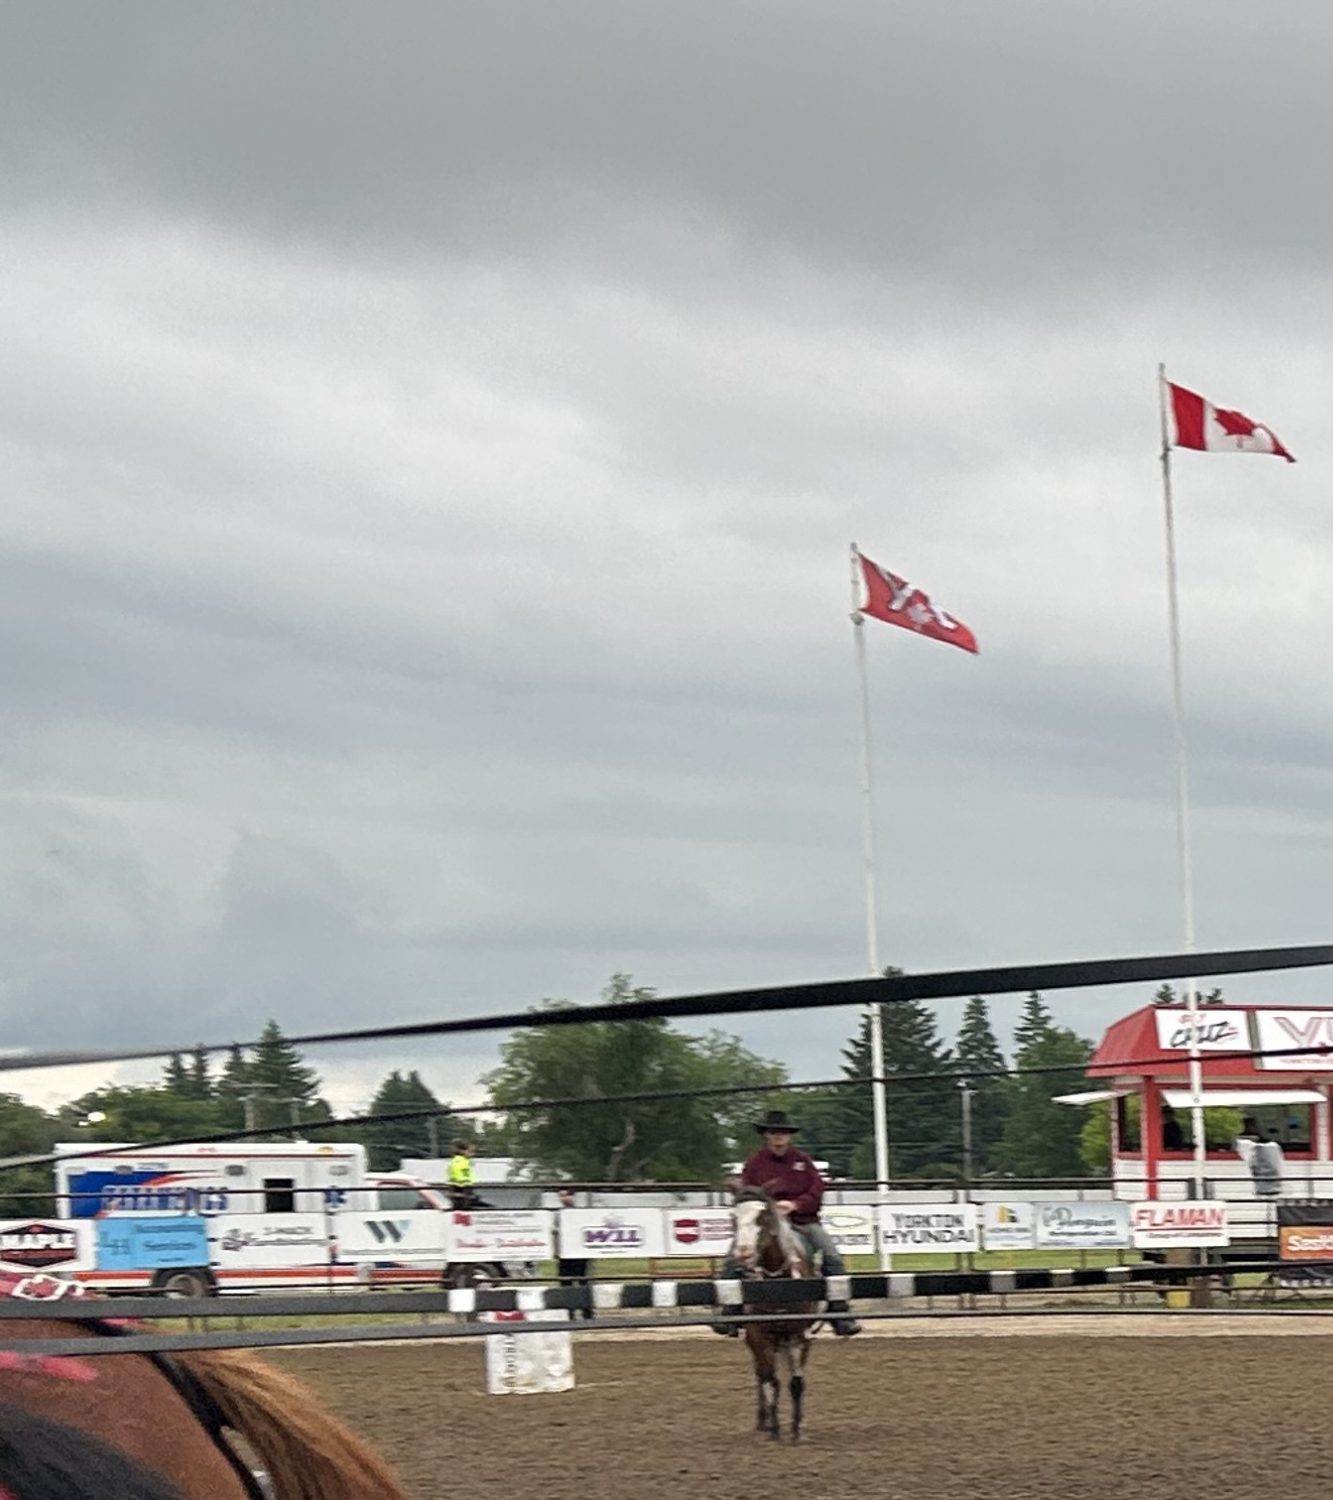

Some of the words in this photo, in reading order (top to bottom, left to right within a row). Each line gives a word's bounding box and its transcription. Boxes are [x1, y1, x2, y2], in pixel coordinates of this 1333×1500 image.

[891, 1213, 964, 1229] YORKTON
[1135, 1208, 1226, 1227] FLAMAN
[883, 1229, 976, 1244] HYUNDAI
